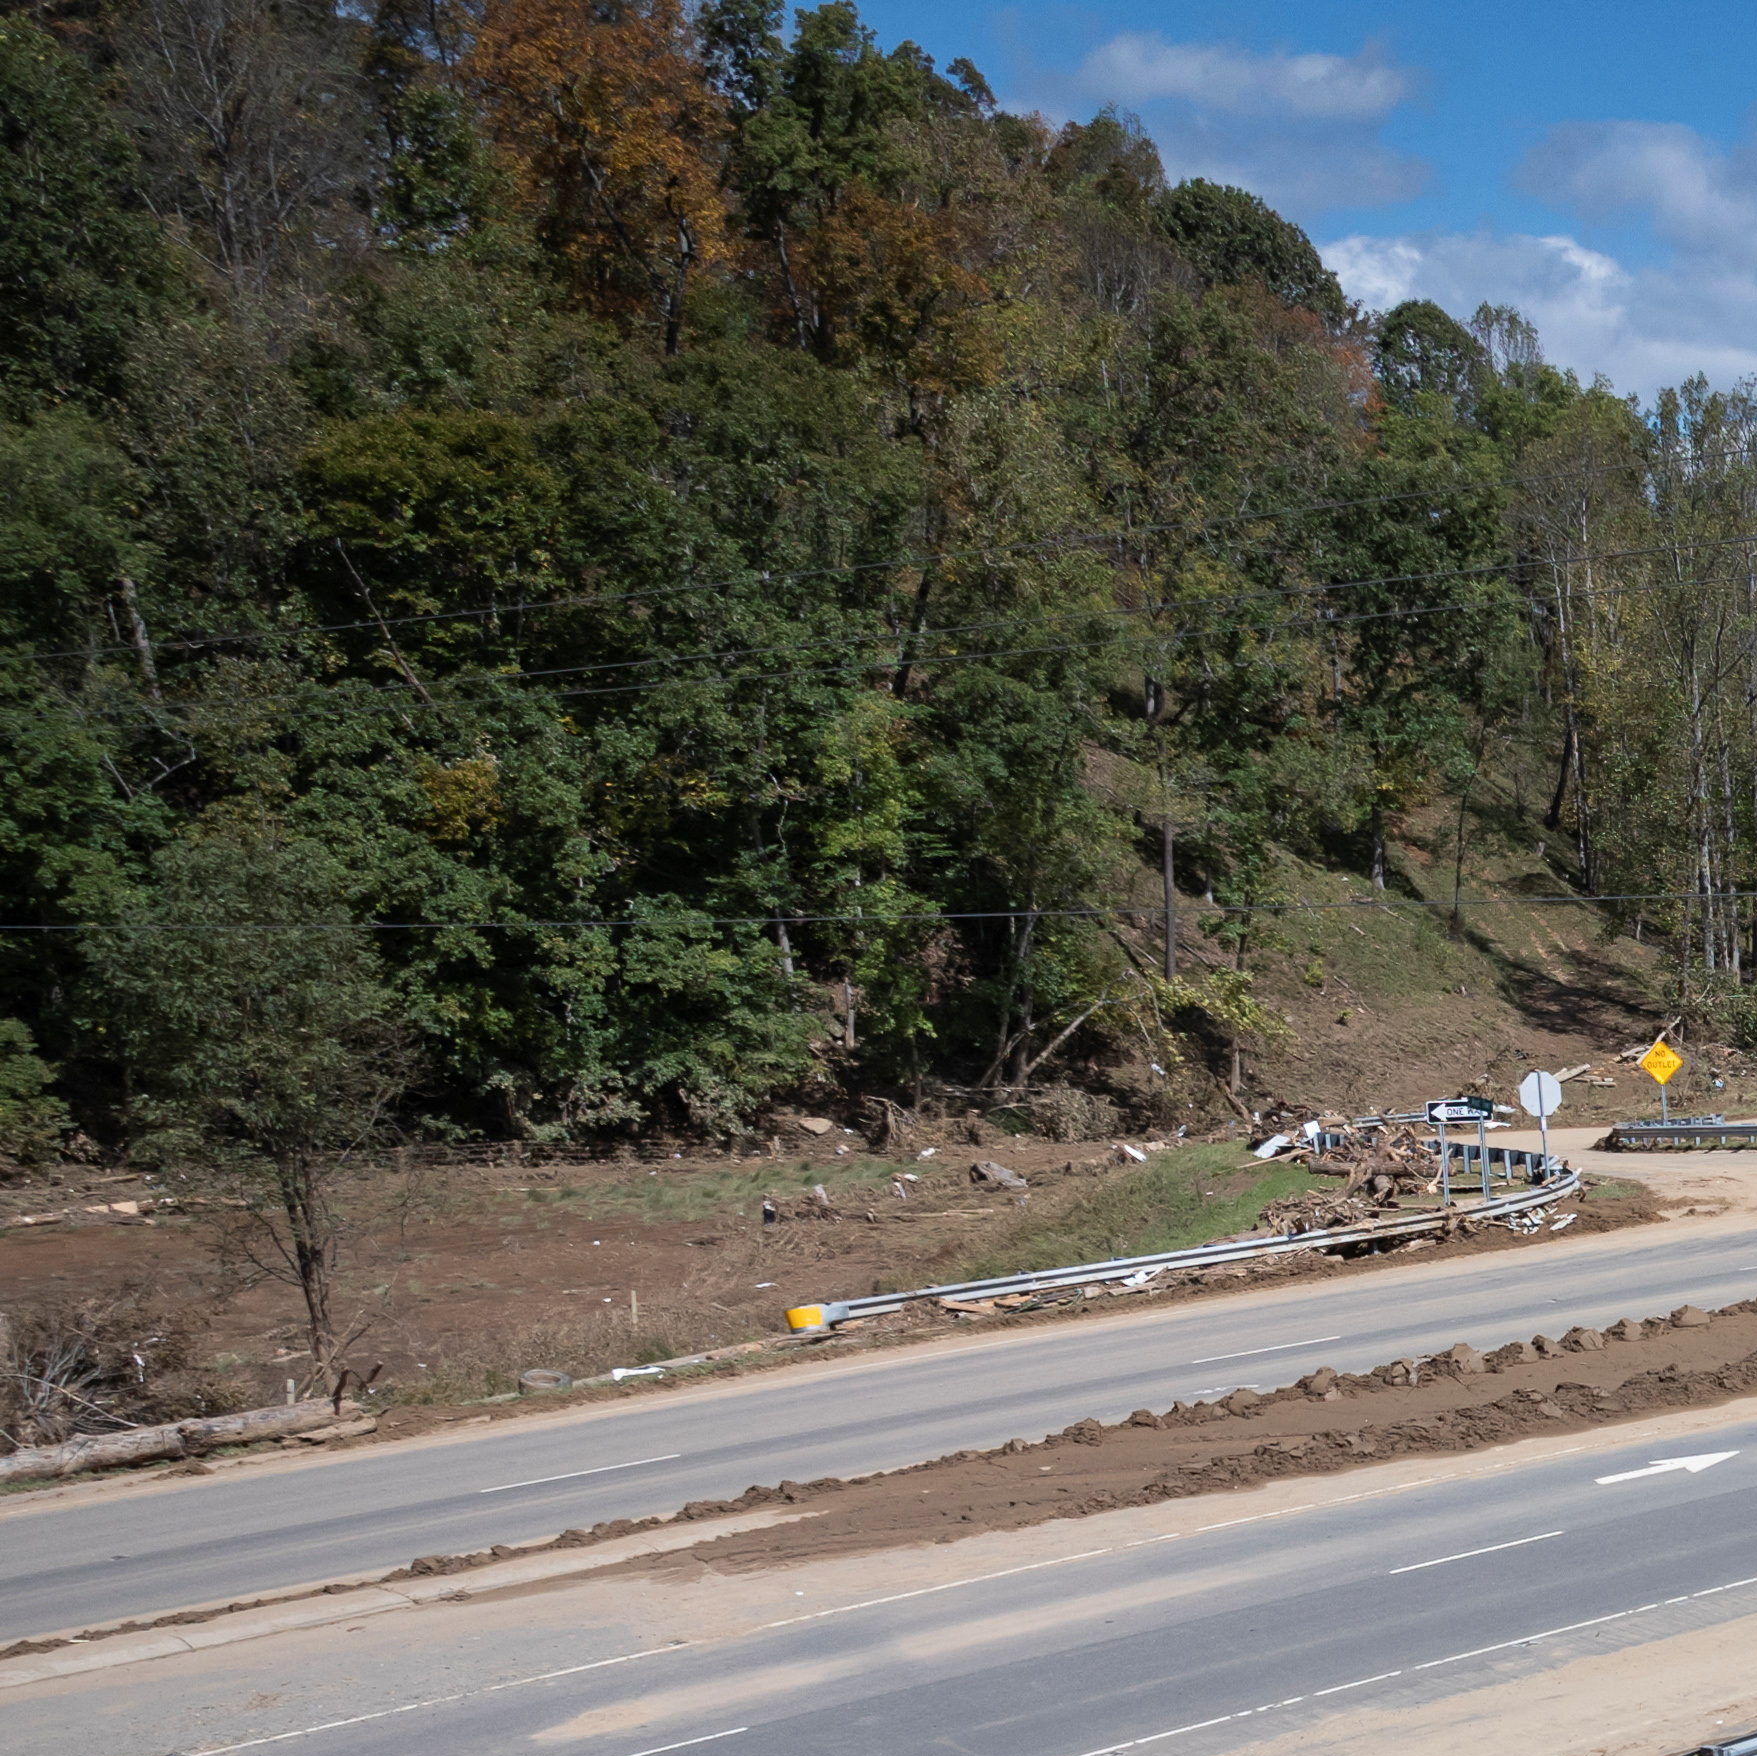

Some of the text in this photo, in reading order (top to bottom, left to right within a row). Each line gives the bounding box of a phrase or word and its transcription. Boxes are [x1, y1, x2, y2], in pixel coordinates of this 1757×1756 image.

[1647, 1060, 1675, 1069] OUTLET
[1446, 1107, 1482, 1116] ONE WA
